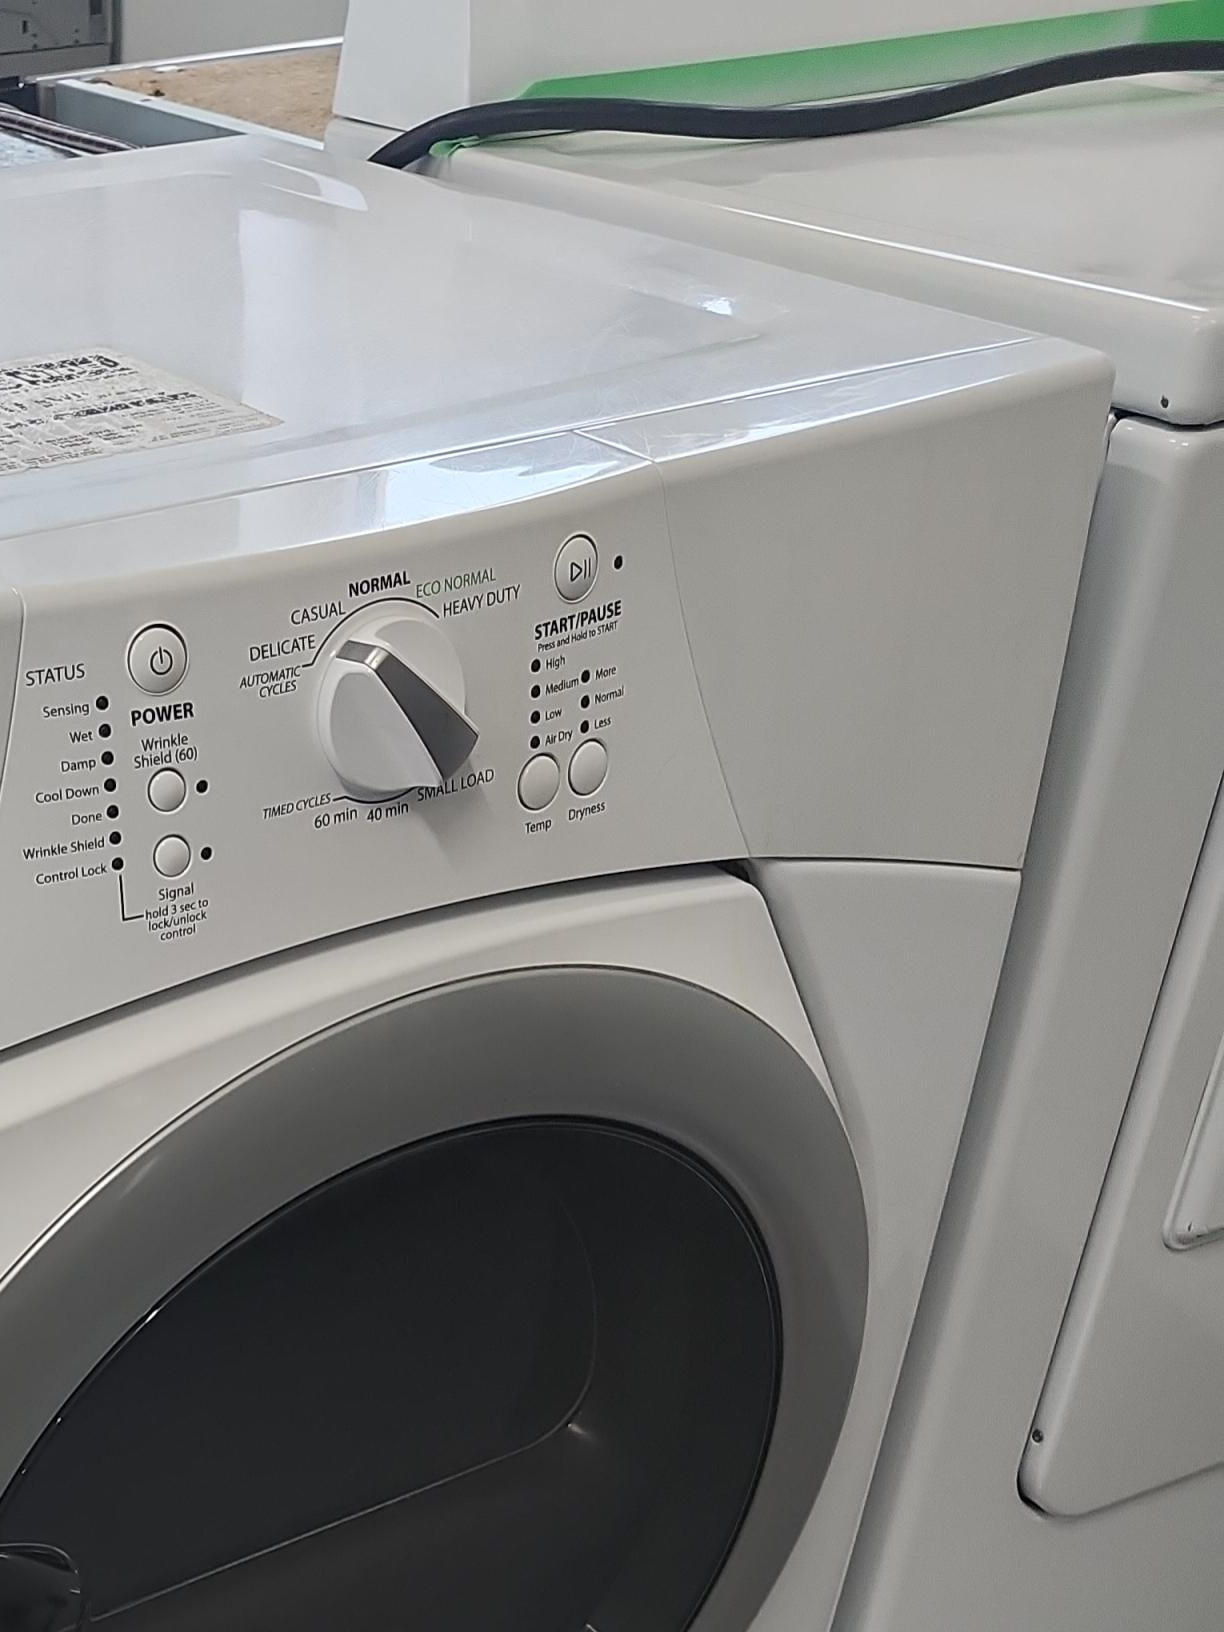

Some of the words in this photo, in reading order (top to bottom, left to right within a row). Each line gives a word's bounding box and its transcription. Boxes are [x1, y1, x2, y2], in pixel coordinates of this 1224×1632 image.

[349, 571, 411, 598] NORMAL
[416, 581, 441, 598] ECO
[444, 568, 496, 591] NORMAL
[443, 595, 484, 617] HEAVY
[486, 585, 521, 605] DUTY
[291, 601, 346, 625] CASUAL
[534, 600, 622, 641] START/PAUSE
[538, 640, 554, 652] Press
[556, 636, 569, 647] and
[571, 630, 587, 644] Hold
[589, 629, 596, 638] to
[597, 621, 618, 636] START
[249, 634, 316, 661] DELICATE
[546, 655, 565, 671] High
[595, 665, 616, 680] More
[26, 664, 85, 687] STATUS
[239, 666, 301, 688] AUTOMATIC
[259, 680, 296, 698] CYCLES
[545, 676, 579, 696] Medium
[594, 686, 624, 705] Normal
[43, 703, 90, 718] Sensing
[131, 703, 194, 726] POWER
[545, 708, 562, 720] Low
[594, 717, 611, 730] Less
[70, 730, 93, 743] Wet
[141, 734, 188, 752] Wrinkle
[545, 733, 557, 746] Air
[558, 730, 573, 743] Dry
[61, 758, 96, 773] Damp
[134, 752, 172, 769] Shield
[175, 748, 198, 763] (60)
[36, 791, 63, 803] Cool
[65, 785, 99, 799] Down
[417, 778, 458, 802] SMALL
[460, 769, 494, 789] LOAD
[263, 801, 293, 820] TIMED
[296, 793, 331, 811] CYCLES
[367, 808, 382, 823] 40
[385, 802, 409, 818] min
[568, 802, 605, 821] Dryness
[72, 811, 102, 825] Done
[314, 813, 330, 829] 60
[333, 809, 358, 824] min
[525, 819, 551, 834] Temp
[23, 844, 68, 860] Wrinkle
[70, 838, 104, 852] Shield
[36, 868, 79, 885] Control
[81, 864, 107, 877] Lock
[158, 883, 194, 901] Signal
[145, 906, 168, 920] hold
[171, 905, 177, 915] 3
[179, 903, 196, 912] sec
[198, 899, 208, 908] to
[148, 910, 207, 932] lock/unlock
[160, 925, 196, 941] control
